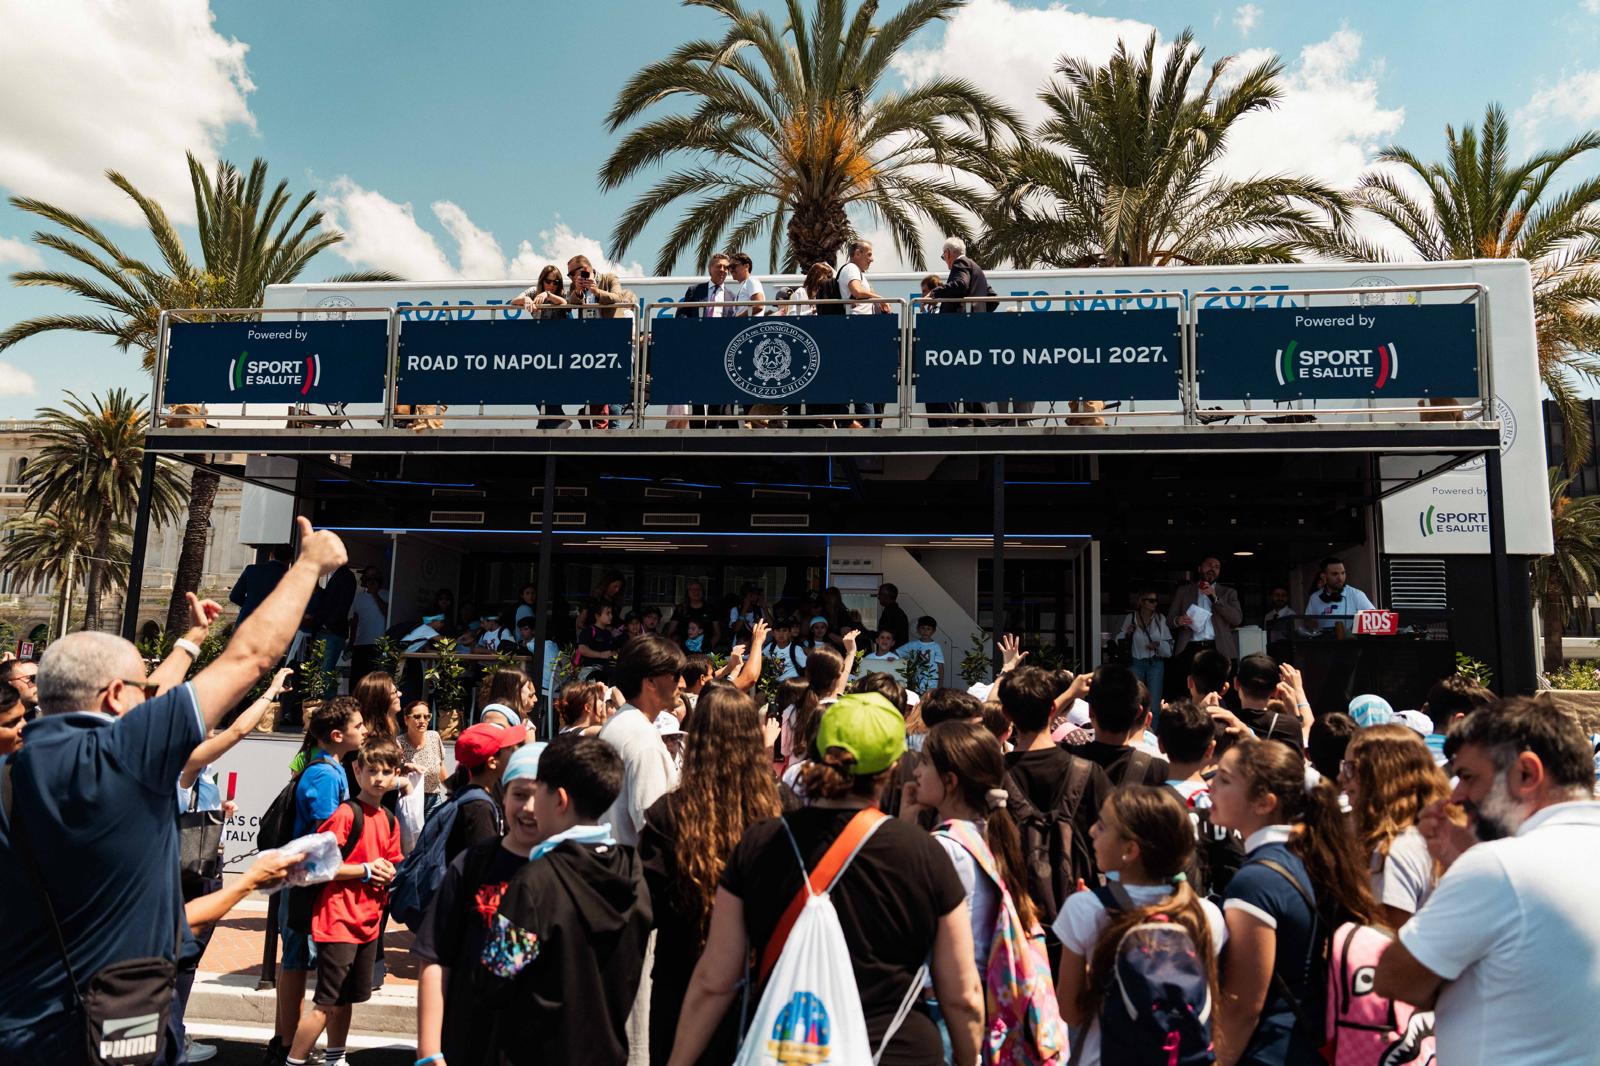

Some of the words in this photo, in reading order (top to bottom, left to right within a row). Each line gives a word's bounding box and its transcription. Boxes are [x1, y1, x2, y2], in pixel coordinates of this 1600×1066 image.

[1295, 314, 1354, 327] Powered
[1359, 314, 1376, 328] by
[248, 329, 292, 339] Powered
[295, 329, 307, 341] by
[760, 325, 799, 336] CONSIGLIO
[805, 339, 816, 371] MINISTRI
[407, 355, 459, 370] ROAD
[464, 354, 488, 370] TO
[493, 353, 563, 370] NAPOLI
[925, 350, 983, 366] ROAD
[989, 349, 1016, 365] TO
[1022, 347, 1101, 365] NAPOLI
[1299, 350, 1373, 365] SPORT
[247, 361, 303, 373] SPORT
[1299, 367, 1309, 378] E
[1312, 367, 1374, 378] SALUTE
[246, 376, 254, 385] E
[256, 375, 302, 385] SALUTE
[735, 377, 778, 395] PALAZZO
[781, 376, 809, 394] CHIGI
[1497, 402, 1513, 440] MINISTRI
[1432, 487, 1474, 495] Powered
[1476, 487, 1487, 497] by
[1436, 512, 1487, 523] SPORT
[1436, 524, 1443, 533] E
[1445, 524, 1488, 533] SALUTE
[1362, 611, 1392, 630] RDS
[226, 816, 246, 826] A'S
[226, 830, 256, 842] TALY
[100, 1034, 157, 1059] PUMA
